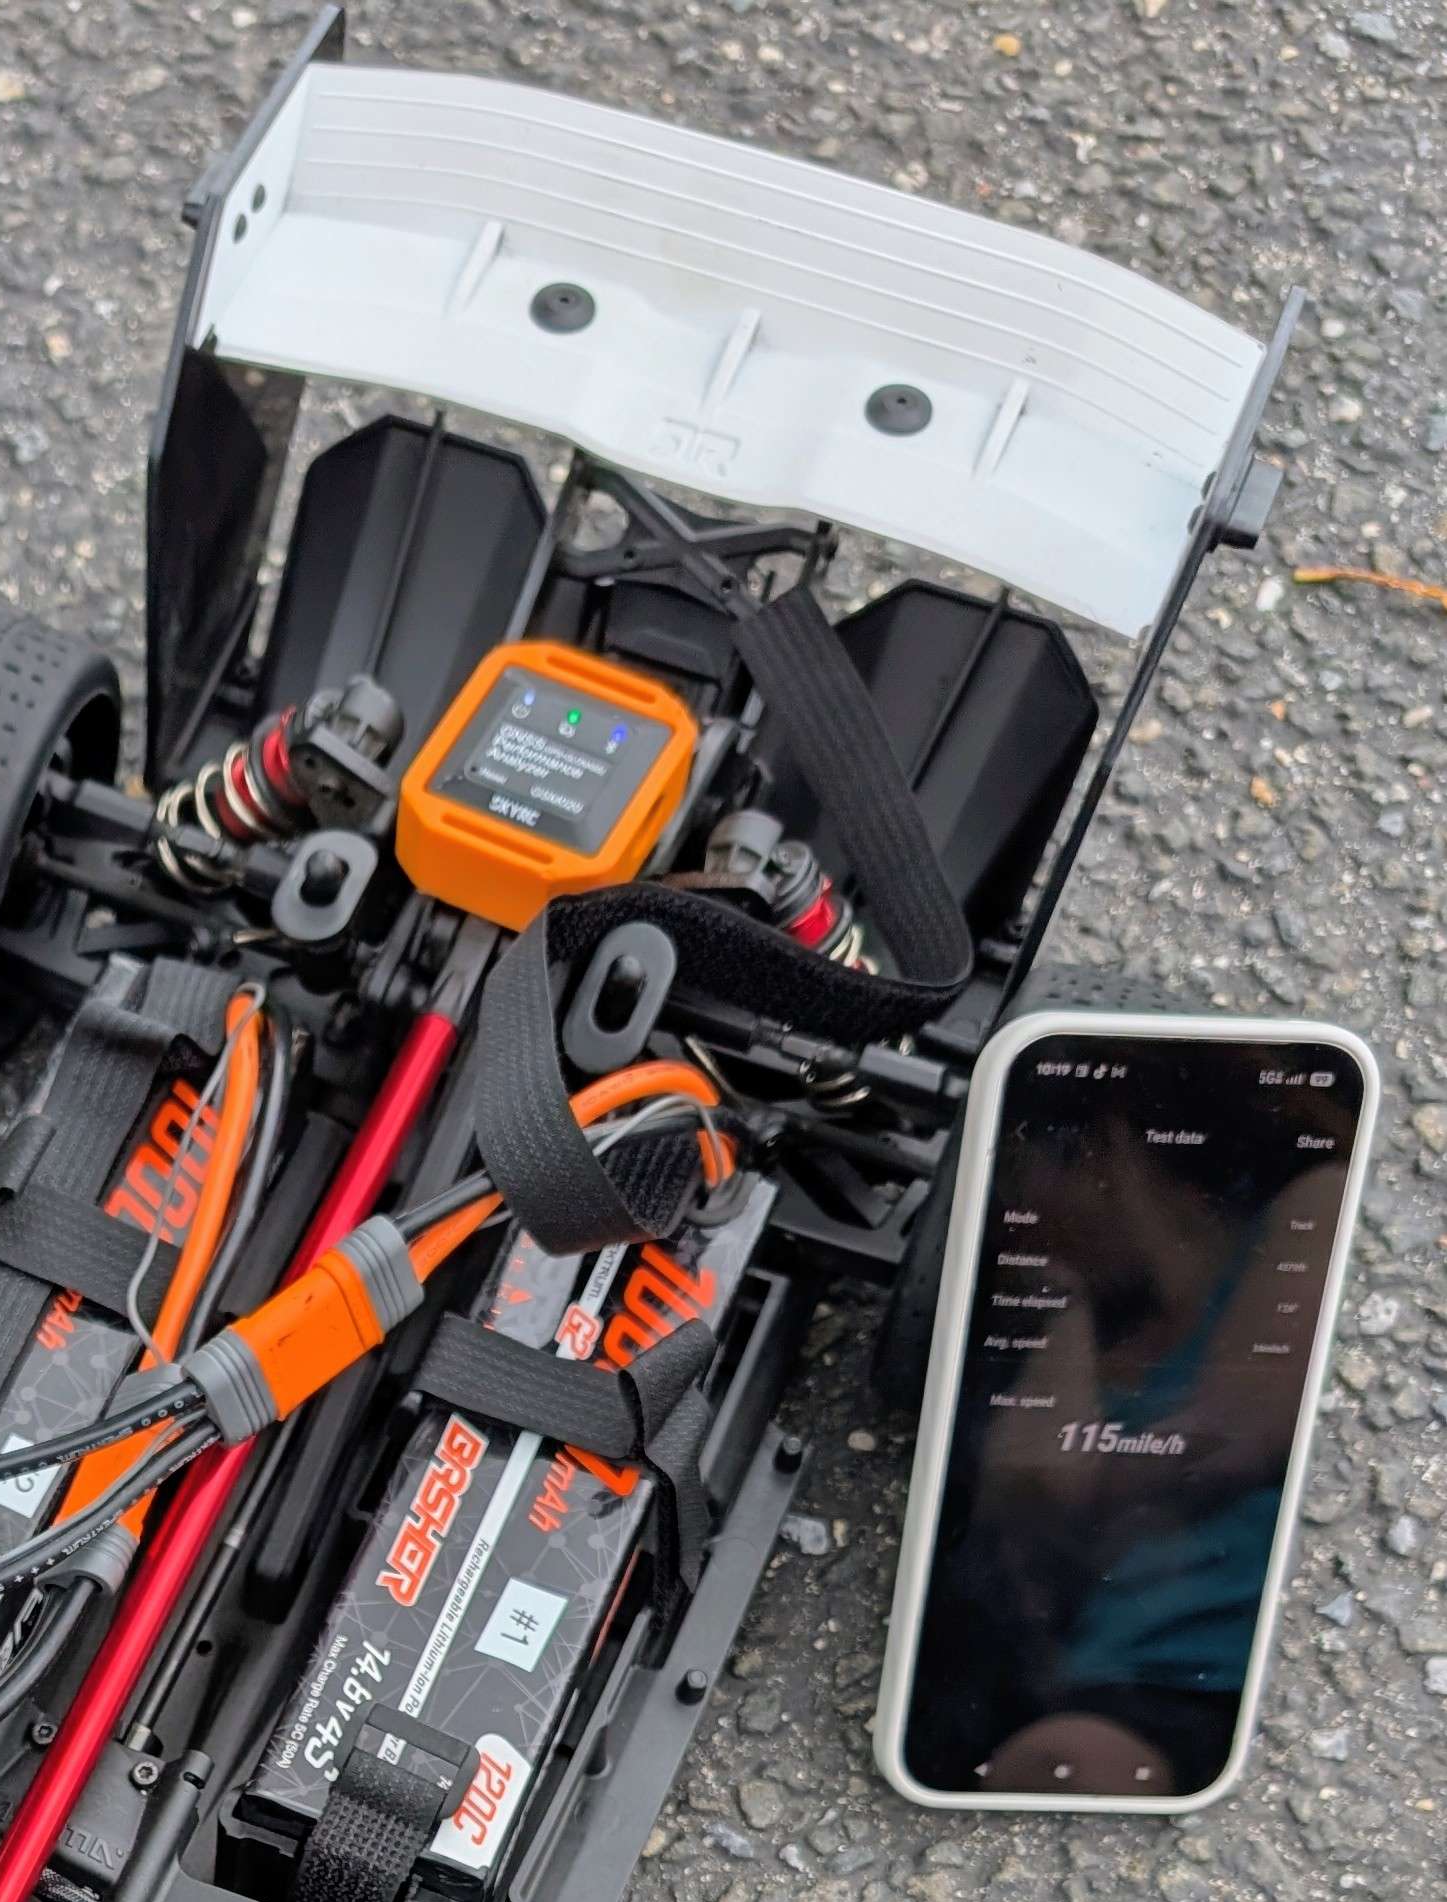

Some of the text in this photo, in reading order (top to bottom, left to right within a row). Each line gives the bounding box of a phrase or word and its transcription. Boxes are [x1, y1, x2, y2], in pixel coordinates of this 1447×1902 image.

[489, 795, 541, 827] SKYRC
[1146, 1130, 1205, 1146] Test data
[1297, 1136, 1335, 1151] Share
[1004, 1210, 1039, 1225] Mode
[997, 1253, 1048, 1267] Distance
[992, 1295, 1067, 1309] Time elapsed
[558, 1303, 602, 1361] G2
[984, 1336, 1047, 1350] Avg. speed
[1020, 1395, 1055, 1408] speed
[377, 1412, 489, 1606] BASHER
[414, 1538, 490, 1694] Rechargeable Lithium-Ion
[499, 1606, 540, 1646] #1
[328, 1634, 348, 1659] Max
[310, 1659, 337, 1697] Charge
[298, 1698, 320, 1723] Rate
